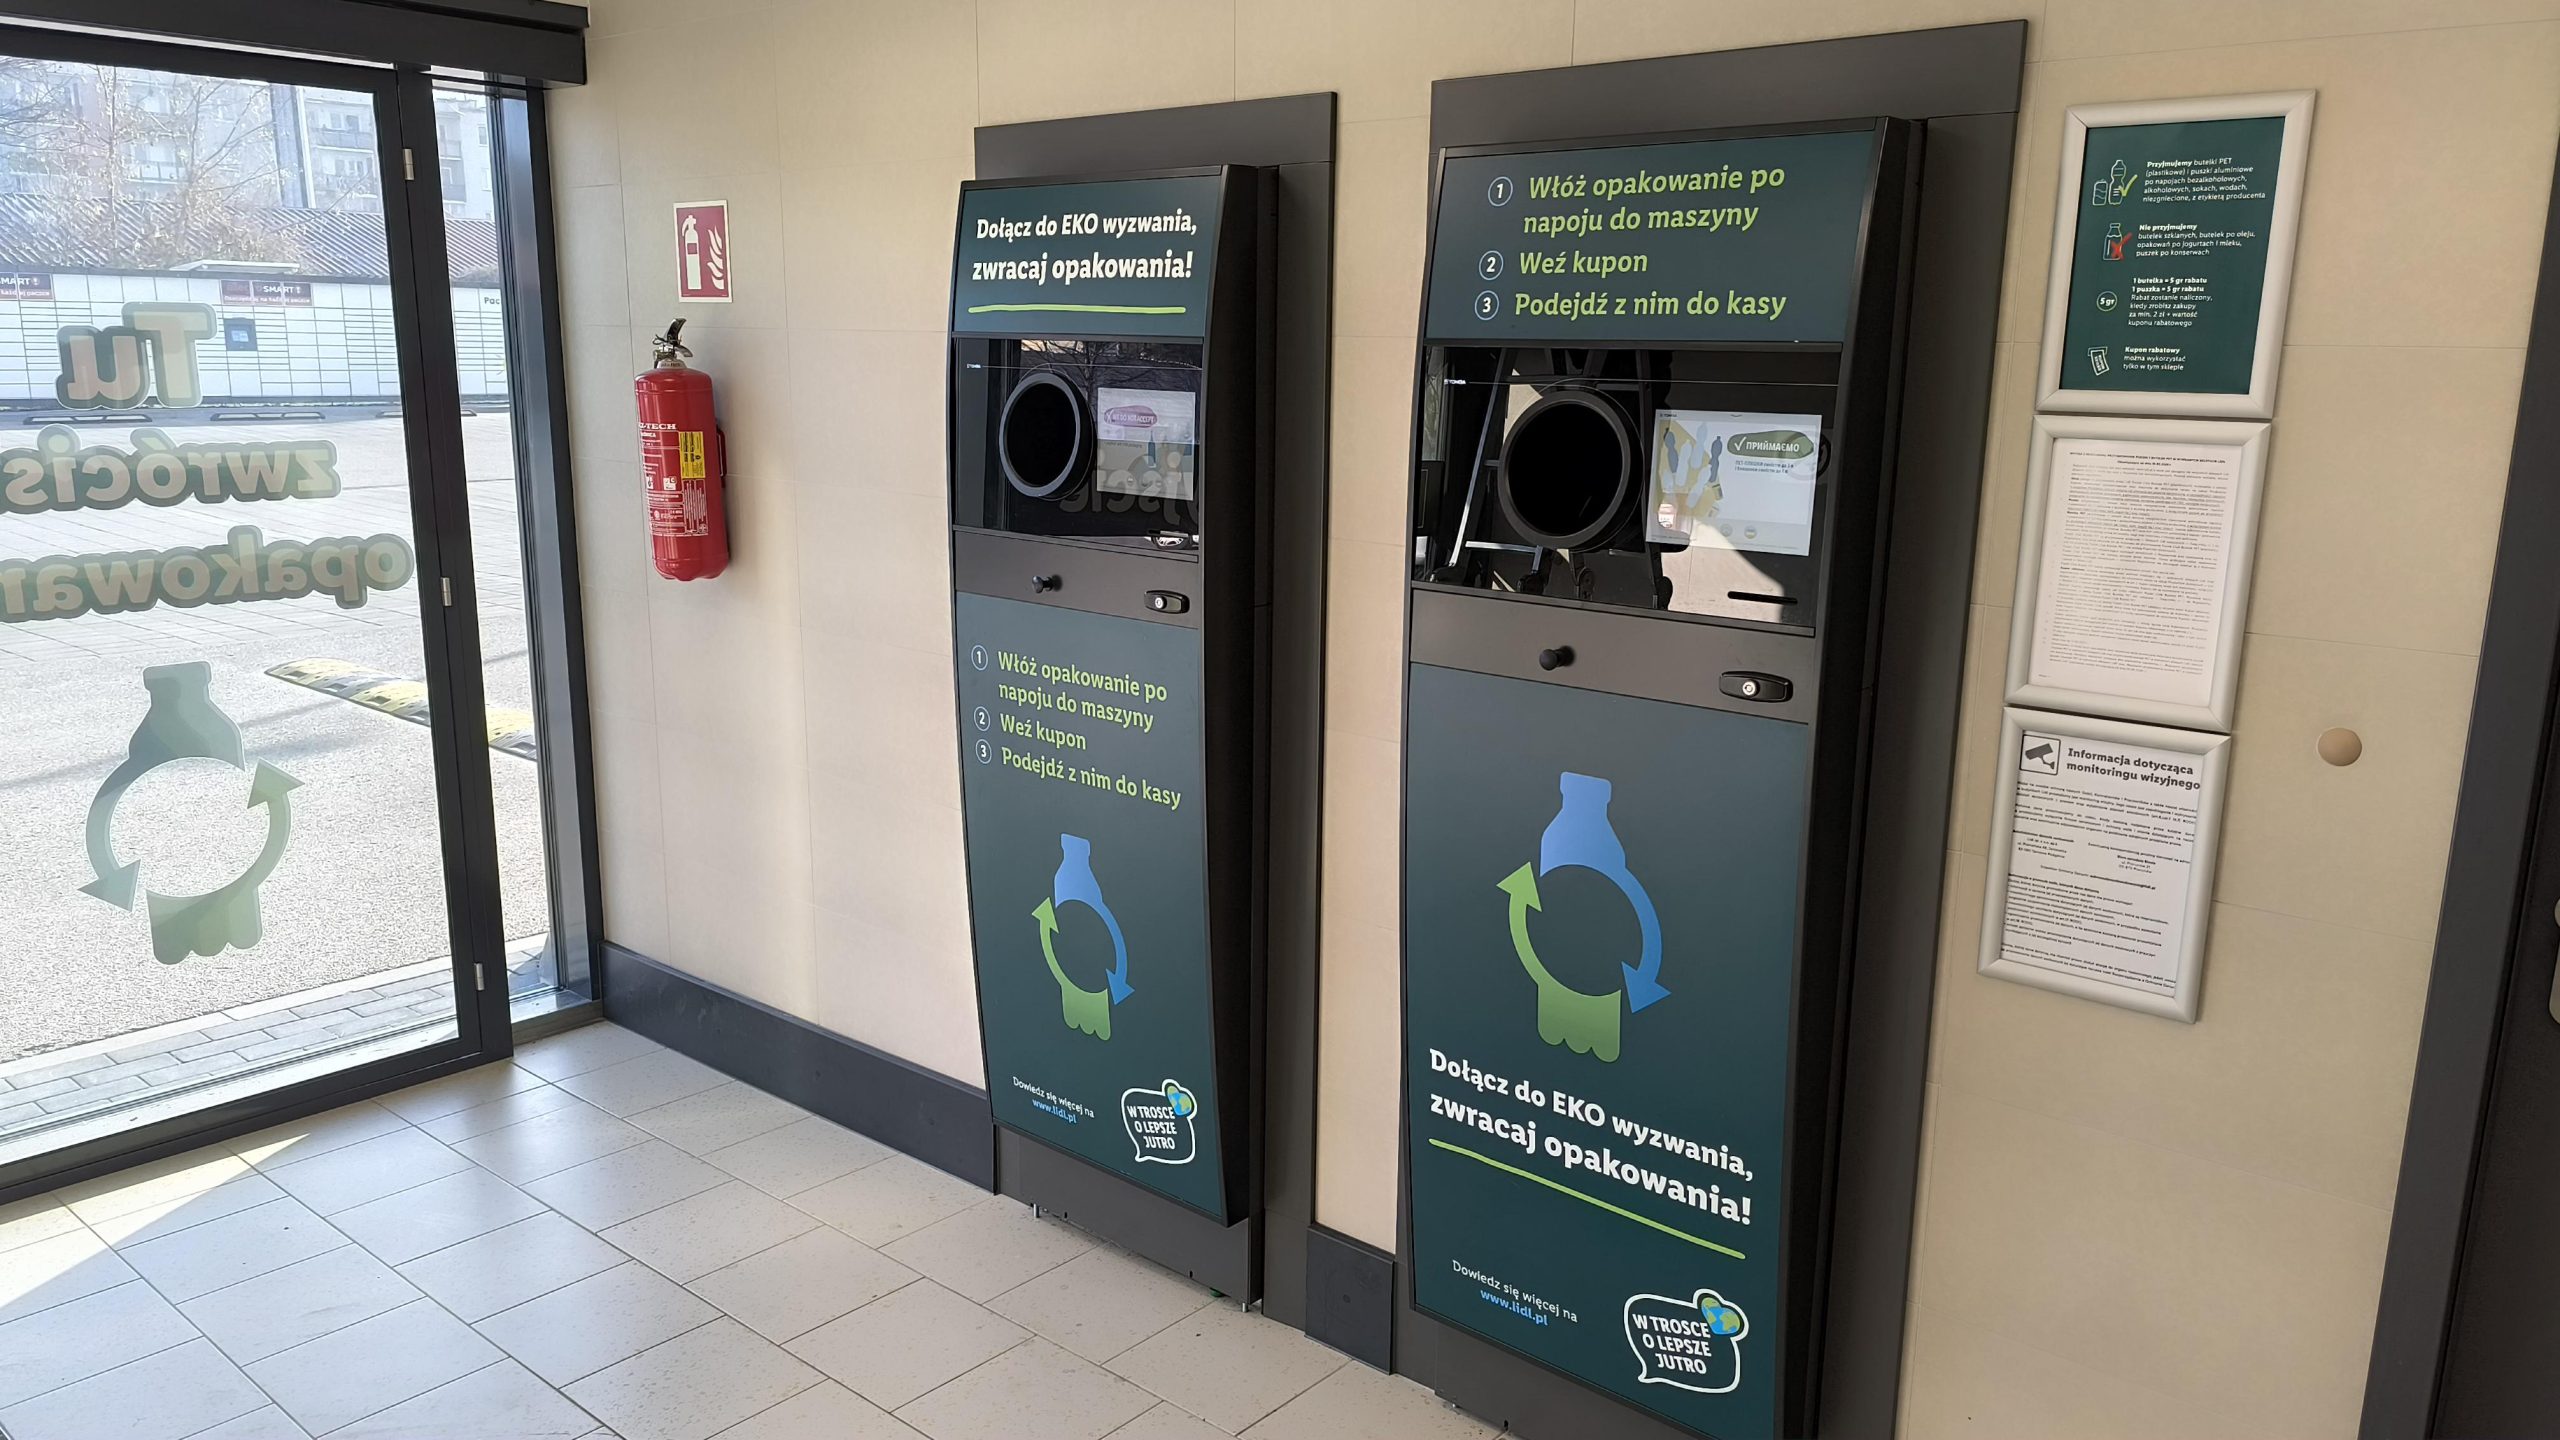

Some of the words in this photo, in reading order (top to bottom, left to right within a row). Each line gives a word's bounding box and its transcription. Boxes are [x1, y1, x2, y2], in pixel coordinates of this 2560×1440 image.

[2145, 168, 2186, 177] (plastikowe)
[2147, 160, 2192, 168] Przyjmujemy
[1497, 183, 1503, 198] 1
[1529, 175, 1586, 199] Włóż
[1592, 165, 1743, 201] opakowanie
[1750, 168, 1785, 193] po
[2144, 186, 2190, 194] alkoholowych,
[2155, 177, 2186, 185] napojach
[2187, 175, 2247, 183] bezalkoholowych,
[2142, 194, 2190, 203] niezgniecione,
[2198, 193, 2225, 201] etykietą
[2226, 192, 2266, 200] producenta
[977, 217, 1031, 243] Dołącz
[1035, 215, 1057, 237] do
[1062, 213, 1098, 235] EKO
[1103, 208, 1197, 238] wyzwania,
[1523, 209, 1602, 238] napoju
[1609, 207, 1640, 231] do
[1648, 206, 1758, 232] maszyny
[2182, 240, 2214, 248] jogurtach
[2220, 239, 2242, 247] mleku,
[972, 252, 1048, 286] zwracaj
[1052, 249, 1193, 285] opakowania!
[1487, 258, 1495, 272] 2
[1520, 252, 1567, 275] Weź
[1572, 251, 1648, 278] kupon
[1483, 298, 1491, 313] 3
[1515, 292, 1608, 320] Podejdź
[1614, 298, 1626, 315] z
[1633, 291, 1678, 316] nim
[1686, 291, 1719, 316] do
[1727, 291, 1787, 320] kasy
[2125, 346, 2147, 354] Kupon
[2148, 346, 2180, 354] rabatowy
[1746, 440, 1800, 452] ПРИЙМАЄМО
[977, 651, 982, 664] 1
[998, 651, 1038, 677] Włóż
[1041, 664, 1140, 696] opakowanie
[1144, 682, 1168, 703] po
[999, 683, 1052, 710] napoju
[1056, 692, 1077, 713] do
[1081, 700, 1153, 733] maszyny
[979, 712, 985, 725] 2
[1000, 713, 1032, 738] Weź
[1036, 721, 1086, 750] kupon
[2068, 748, 2130, 766] Informacja
[2134, 758, 2193, 775] dotycząca
[981, 744, 987, 758] 3
[1001, 746, 1064, 779] Podejdź
[1068, 766, 1077, 782] z
[1080, 767, 1111, 790] nim
[1115, 775, 1137, 797] do
[1142, 779, 1181, 810] kasy
[2067, 762, 2137, 780] monitoringu
[2140, 773, 2200, 790] wizyjnego
[1013, 1076, 1045, 1097] Dowiedz
[1046, 1091, 1057, 1104] się
[1058, 1096, 1083, 1115] więcej
[1084, 1107, 1095, 1119] na
[1032, 1098, 1077, 1124] www.lidl.pl
[1127, 1105, 1137, 1118] W
[1137, 1105, 1176, 1120] TROSCE
[1429, 1048, 1509, 1093] Dołącz
[1515, 1080, 1546, 1107] do
[1553, 1090, 1605, 1127] EKO
[1612, 1114, 1753, 1182] wyzwania,
[1135, 1121, 1142, 1133] O
[1143, 1121, 1177, 1135] LEPSZE
[1143, 1135, 1176, 1150] JUTRO
[1429, 1093, 1537, 1154] zwracaj
[1544, 1135, 1751, 1226] opakowania!
[1452, 1260, 1501, 1291] Dowiedz
[1503, 1283, 1519, 1299] się
[1522, 1290, 1560, 1317] więcej
[1563, 1308, 1578, 1323] na
[1480, 1289, 1548, 1327] www.lidl.pl
[1632, 1314, 1649, 1331] W
[1649, 1315, 1711, 1338] TROSCE
[1642, 1333, 1655, 1349] O
[1658, 1335, 1712, 1357] LEPSZE
[1655, 1352, 1707, 1374] JUTRO
